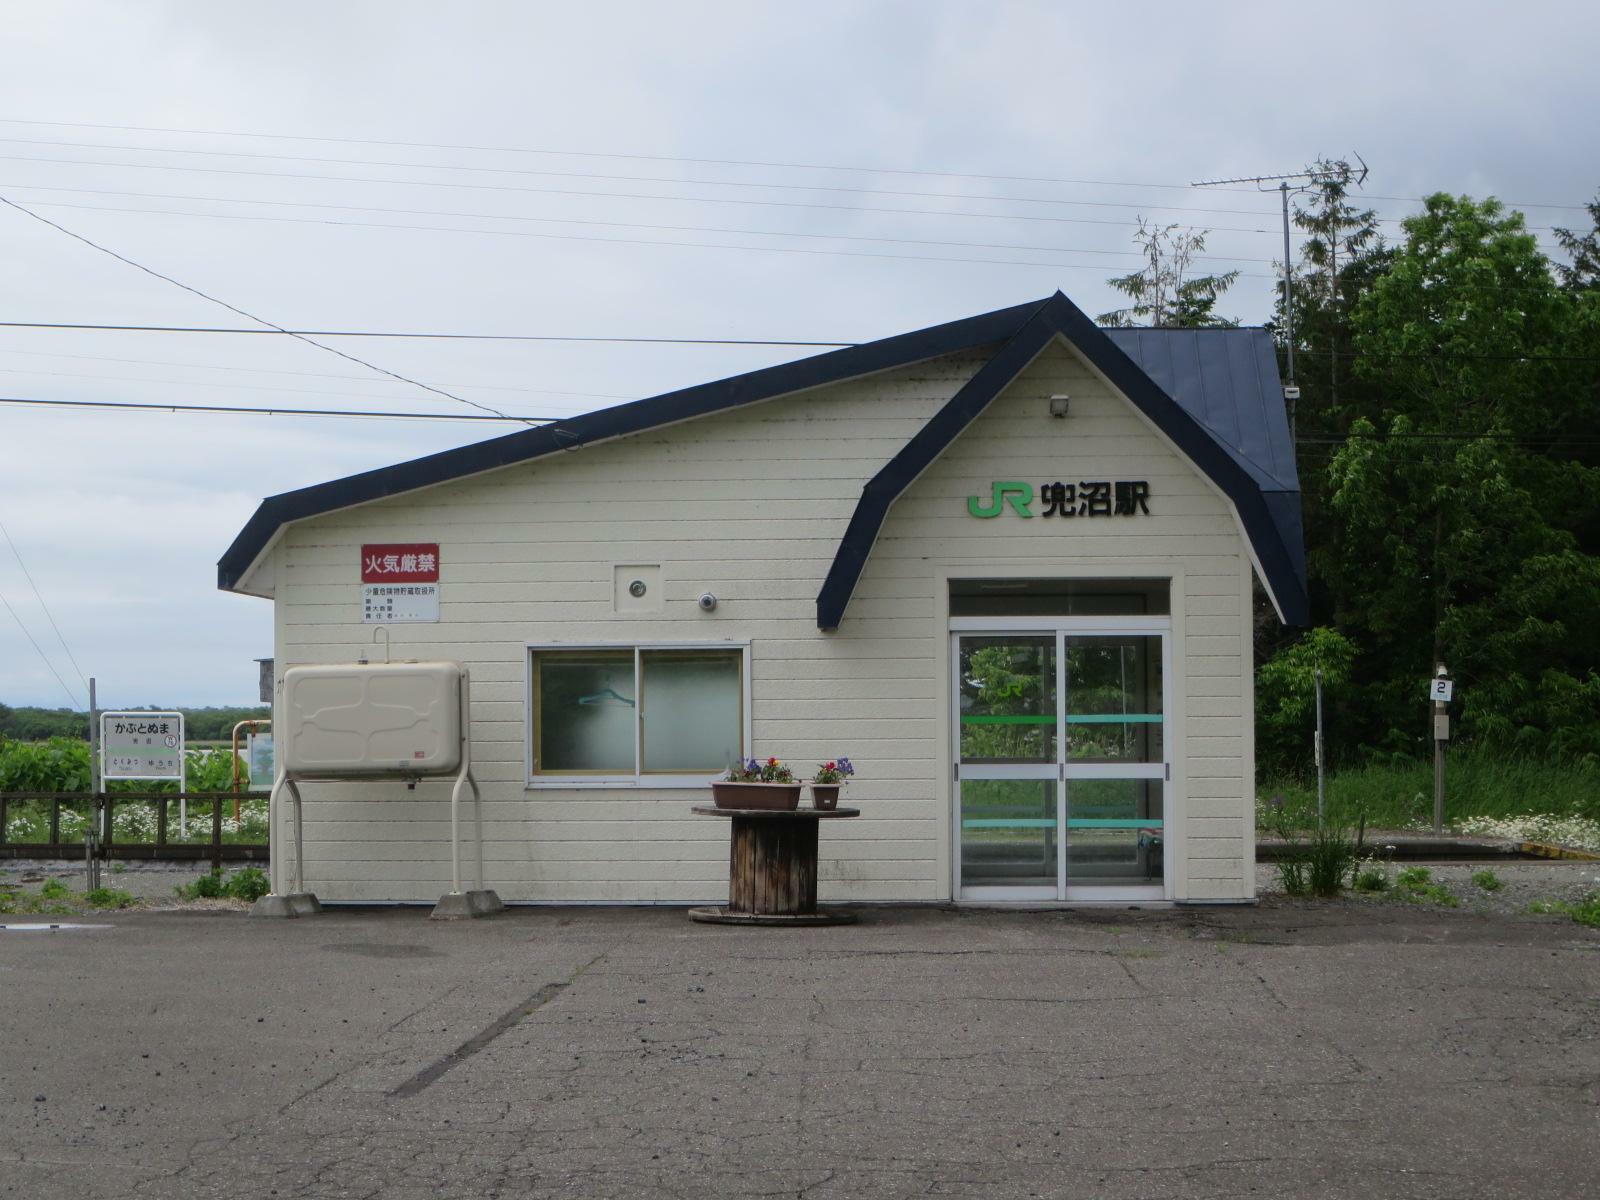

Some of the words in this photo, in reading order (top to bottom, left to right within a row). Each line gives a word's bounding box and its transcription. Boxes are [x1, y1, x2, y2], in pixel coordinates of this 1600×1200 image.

[967, 481, 1034, 518] JR
[1041, 481, 1150, 517] 兜沼駅
[365, 553, 435, 574] 火気厳禁
[1438, 682, 1446, 692] 2
[115, 722, 169, 734] かぶとぬま
